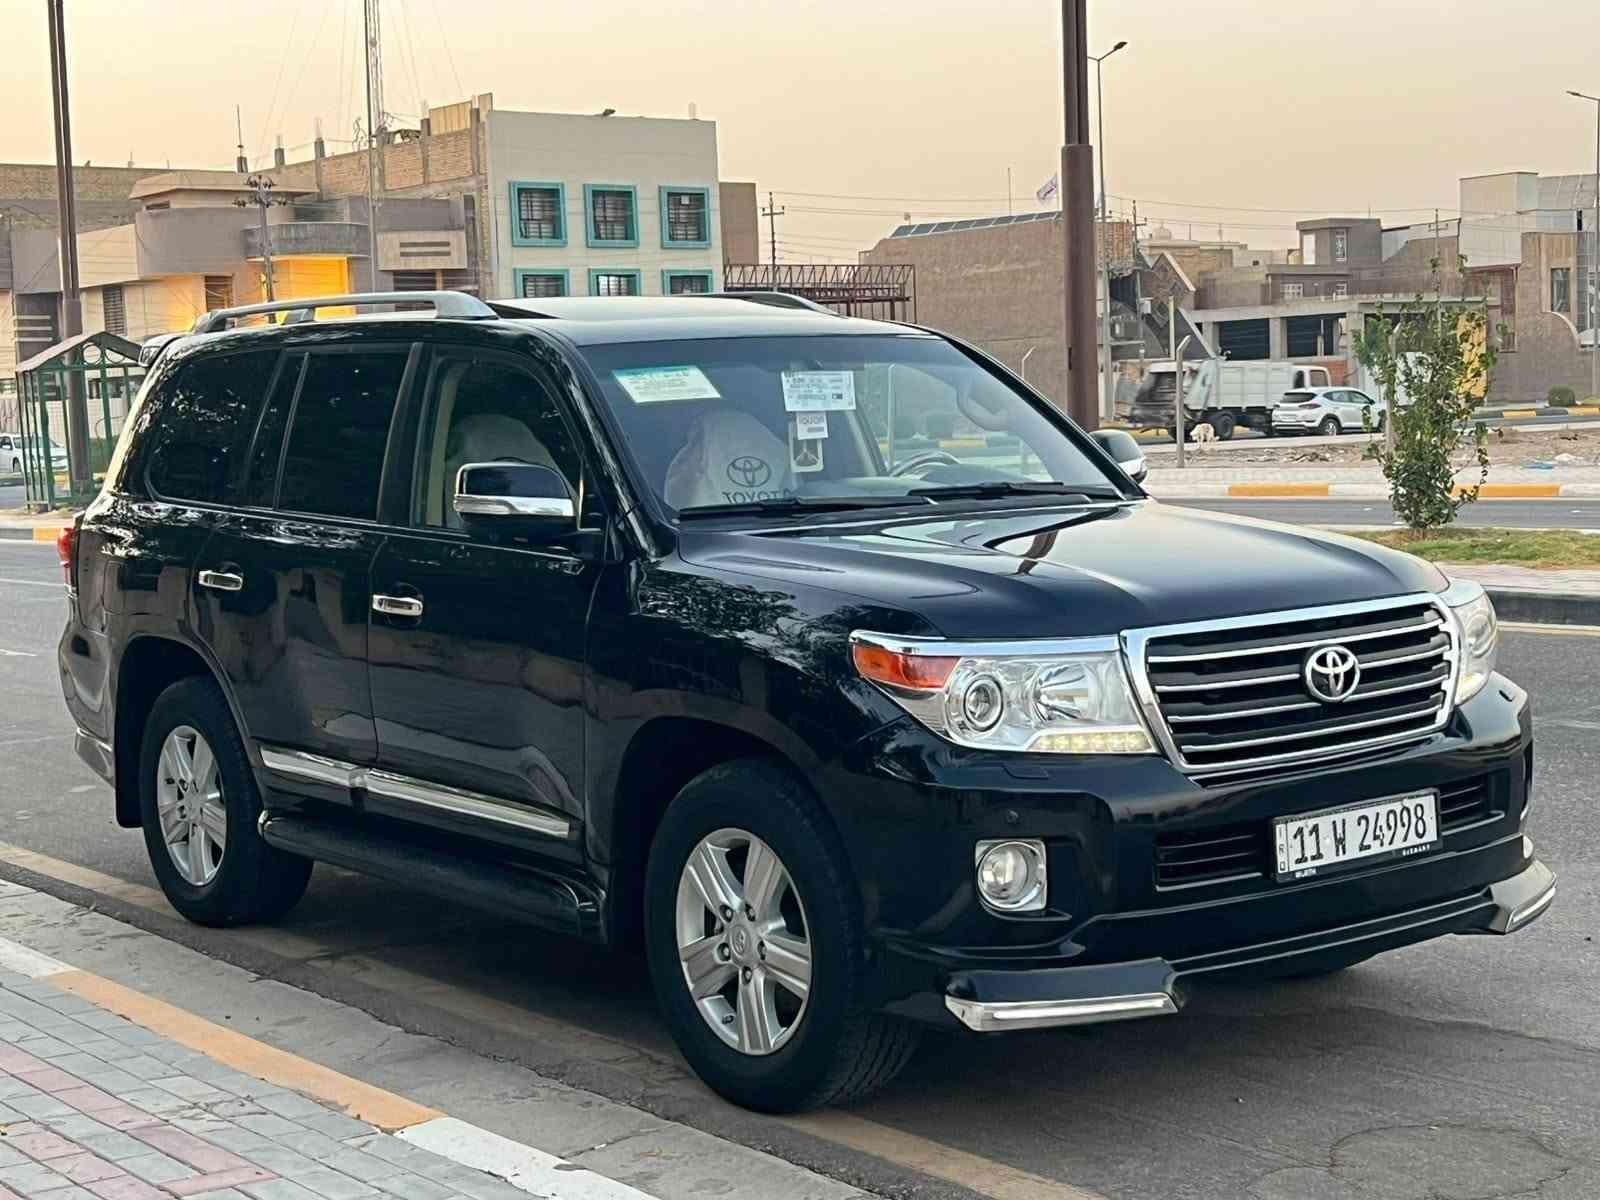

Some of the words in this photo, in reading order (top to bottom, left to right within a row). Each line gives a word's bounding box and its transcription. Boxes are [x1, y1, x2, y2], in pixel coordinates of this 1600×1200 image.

[1293, 823, 1324, 865] 11
[1332, 818, 1347, 858] W
[1357, 803, 1427, 853] 24998
